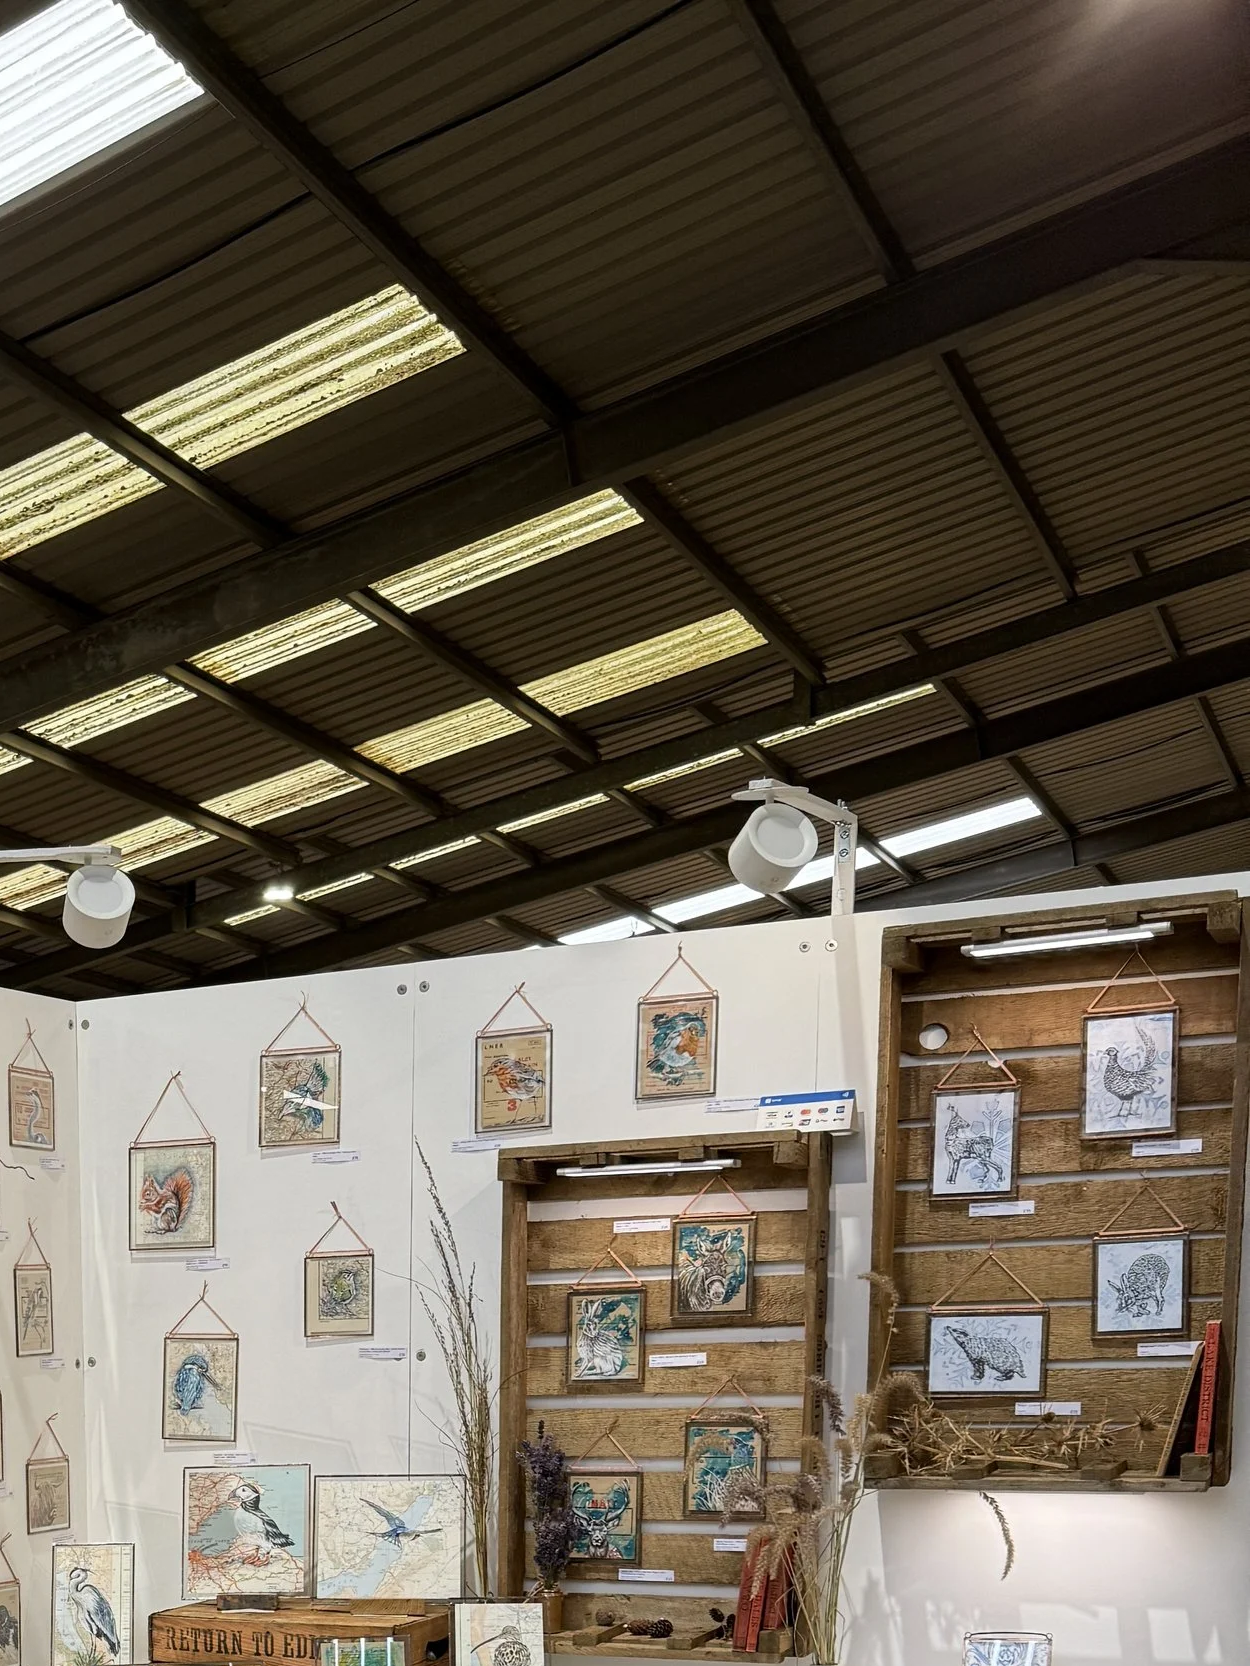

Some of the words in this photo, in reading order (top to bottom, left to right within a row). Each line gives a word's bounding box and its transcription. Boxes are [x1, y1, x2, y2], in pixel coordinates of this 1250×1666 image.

[1200, 1375, 1213, 1422] DISTRICT
[165, 1626, 243, 1656] RETURN
[252, 1631, 275, 1657] TO
